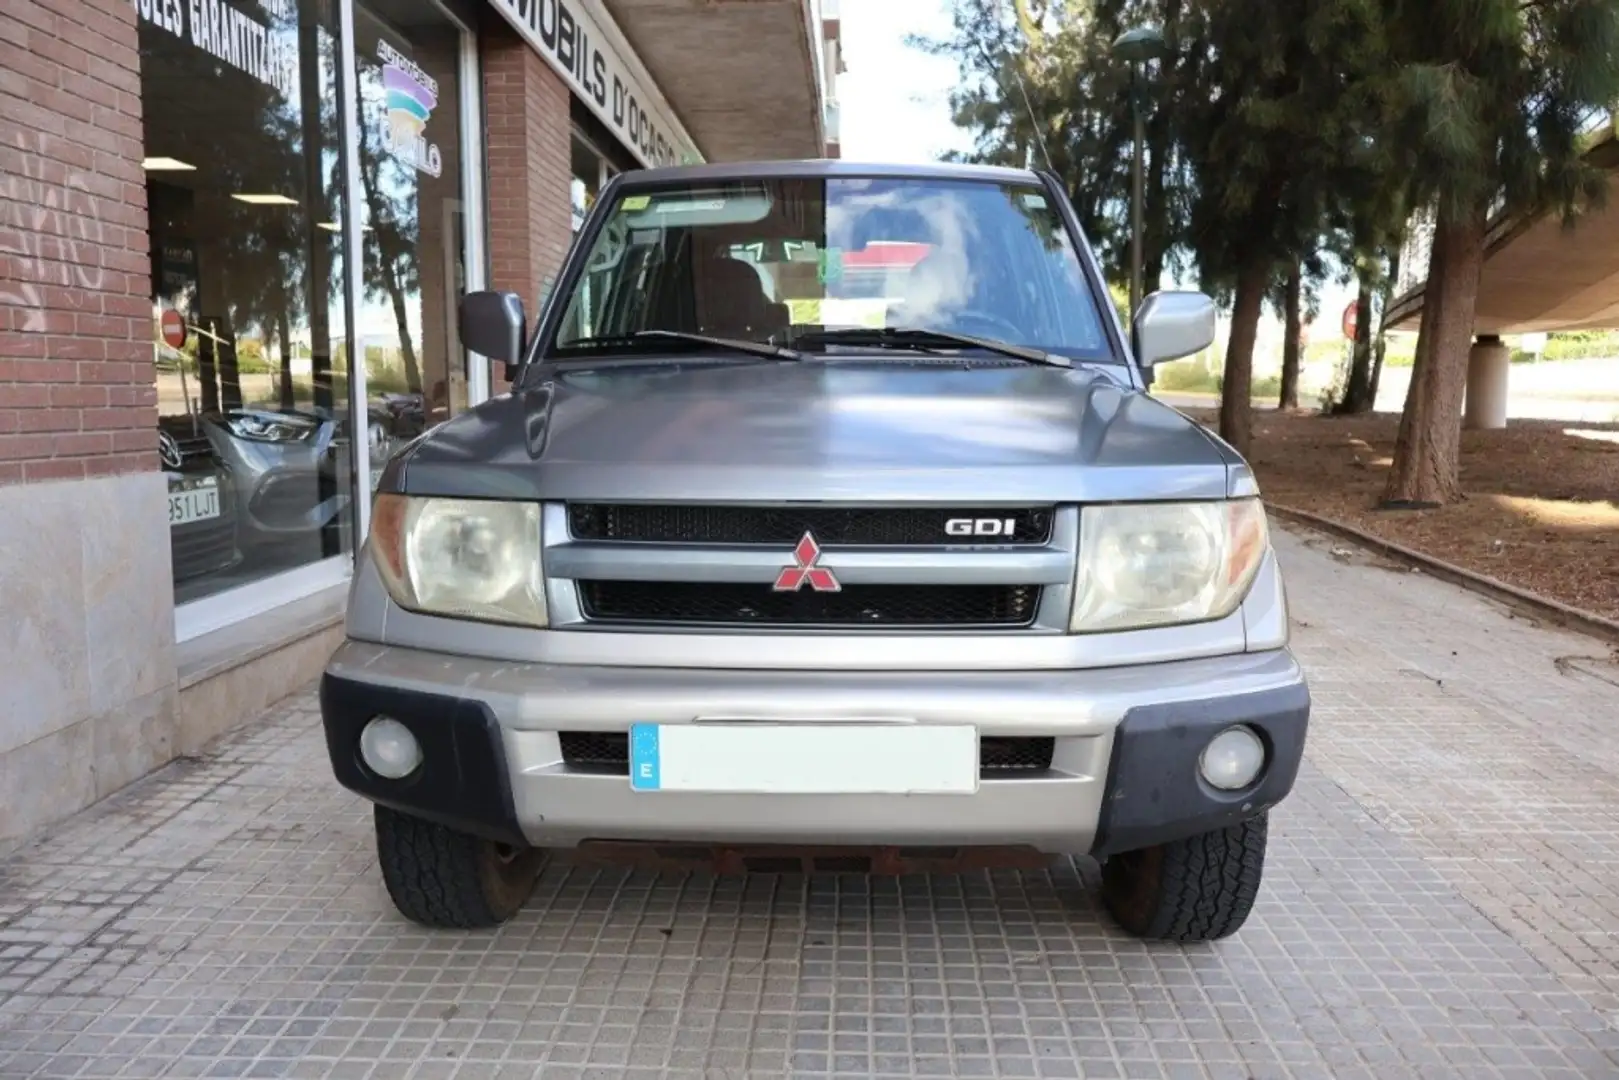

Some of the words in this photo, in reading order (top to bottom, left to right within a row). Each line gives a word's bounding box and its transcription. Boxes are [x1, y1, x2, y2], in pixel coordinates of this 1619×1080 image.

[194, 492, 217, 517] LJT
[945, 518, 1015, 536] GDI
[640, 763, 653, 778] E
